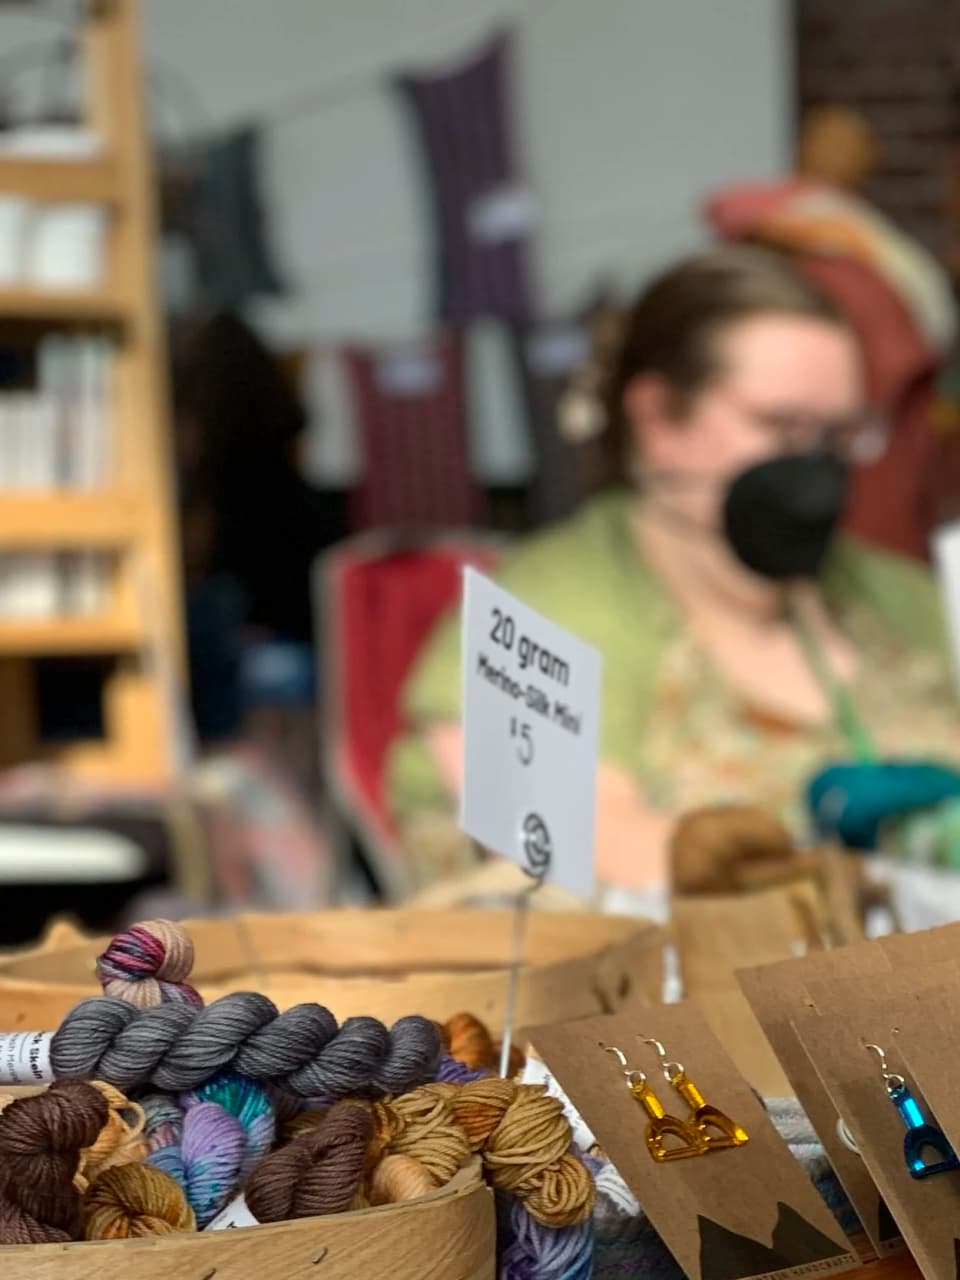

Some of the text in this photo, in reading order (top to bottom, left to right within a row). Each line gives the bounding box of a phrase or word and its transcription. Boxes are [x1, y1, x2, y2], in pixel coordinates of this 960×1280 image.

[489, 606, 570, 686] 20 gram
[553, 701, 581, 736] Mini
